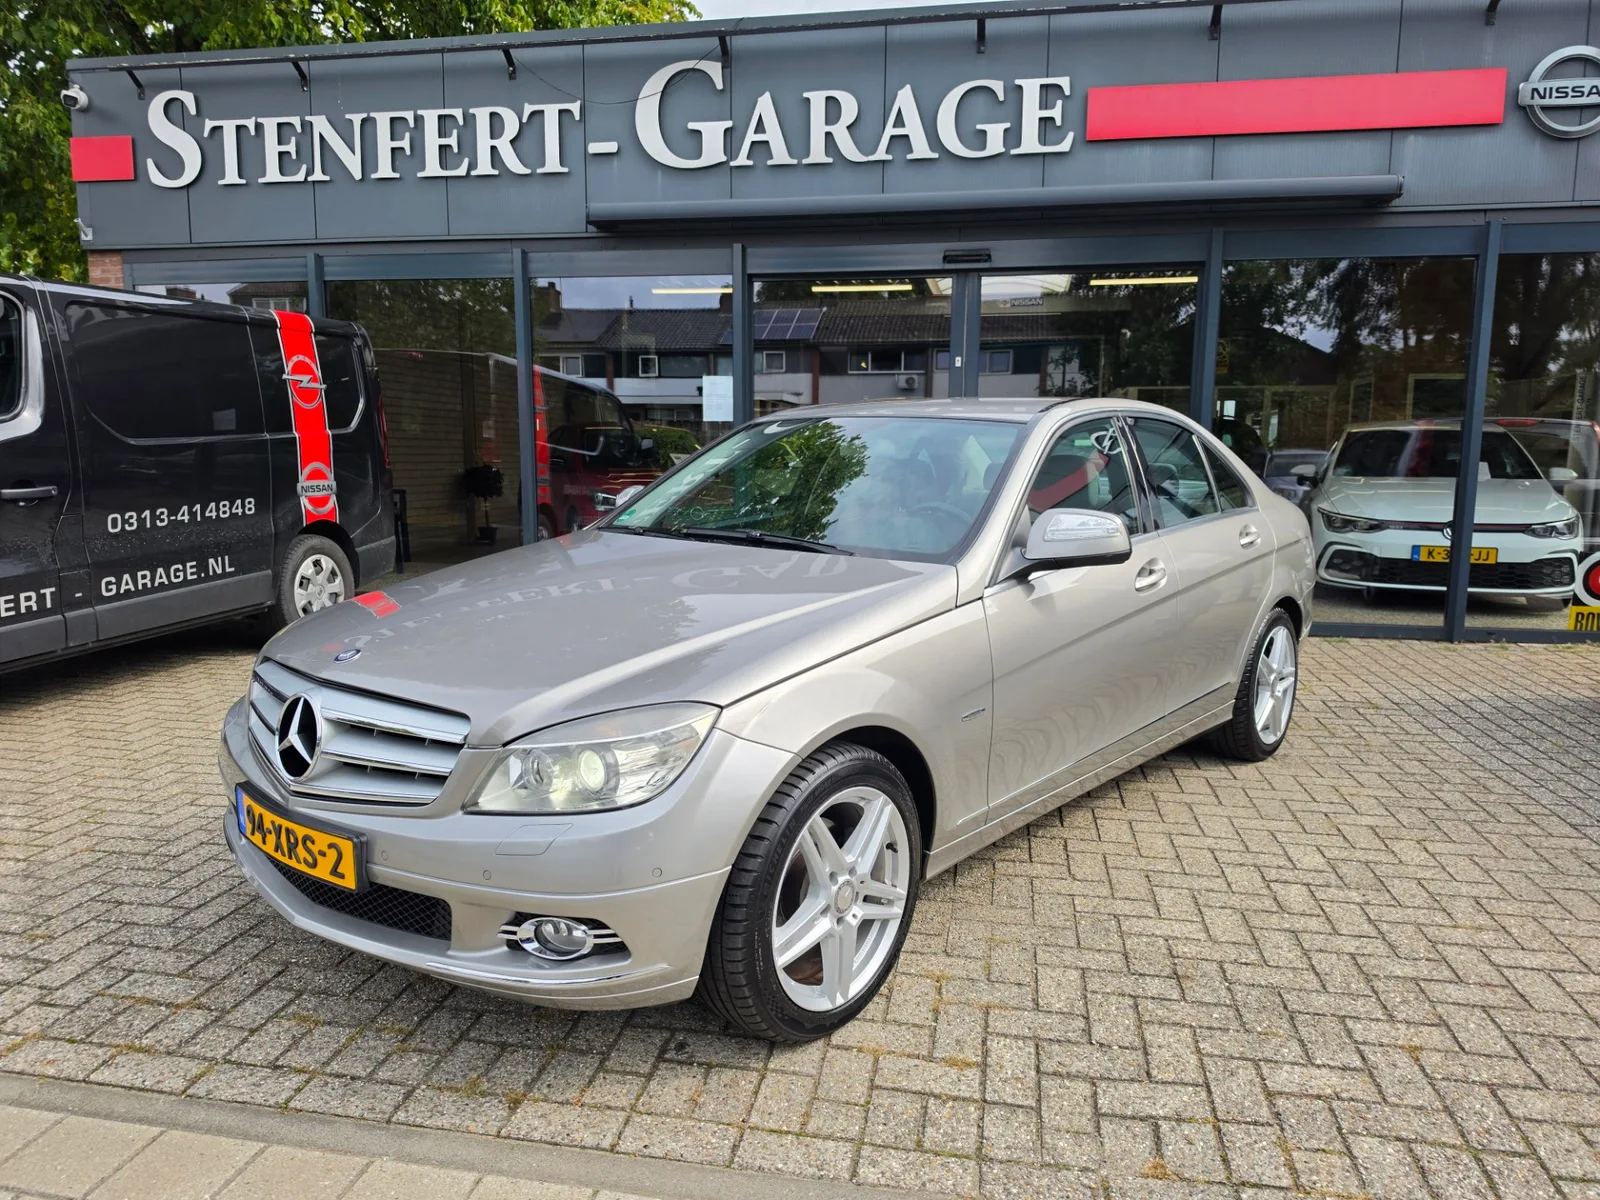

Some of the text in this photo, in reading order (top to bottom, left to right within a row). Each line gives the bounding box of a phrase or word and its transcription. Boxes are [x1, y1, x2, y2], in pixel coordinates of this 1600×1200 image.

[301, 484, 334, 494] NISSAN
[107, 497, 255, 533] 0313-414848
[0, 587, 56, 617] ERT
[101, 555, 235, 597] GARAGE.NL
[246, 804, 346, 880] 94-XRS-2
